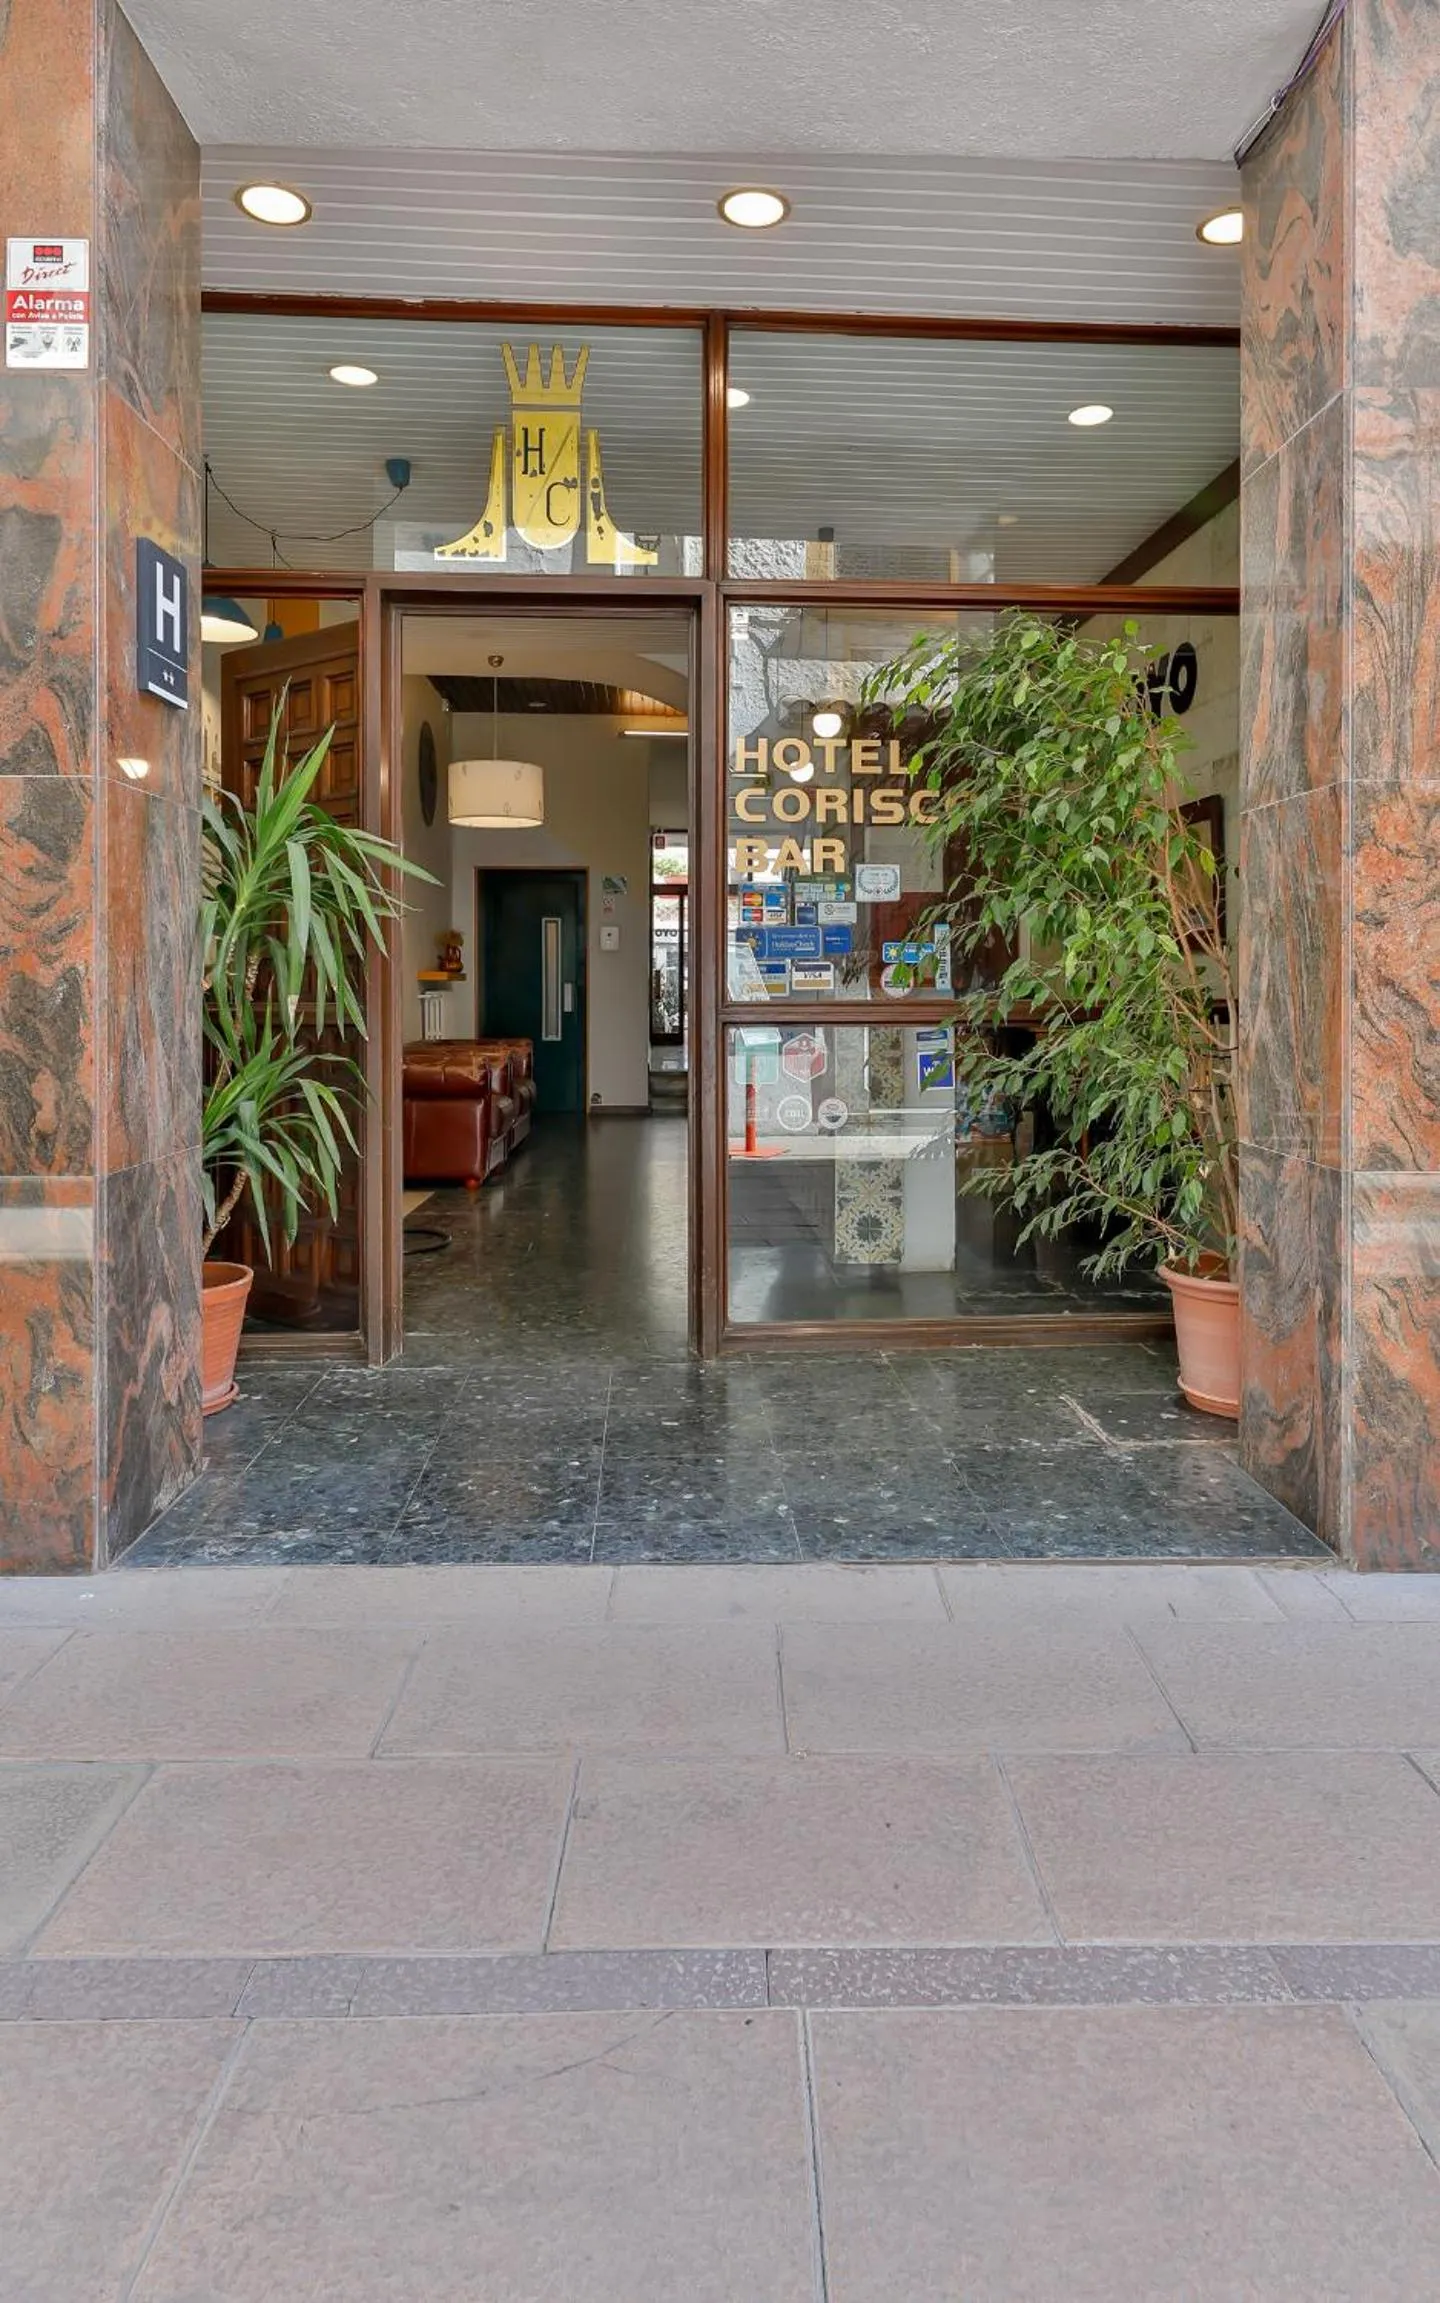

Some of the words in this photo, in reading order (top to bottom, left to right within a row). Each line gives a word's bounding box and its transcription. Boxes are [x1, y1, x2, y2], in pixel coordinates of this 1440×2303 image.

[22, 262, 77, 285] Direct
[12, 294, 85, 311] Alarma
[521, 427, 545, 475] H
[546, 481, 575, 526] C
[156, 561, 181, 654] H
[735, 736, 909, 775] HOTEL
[735, 838, 847, 875] BAR
[655, 928, 678, 937] OYO
